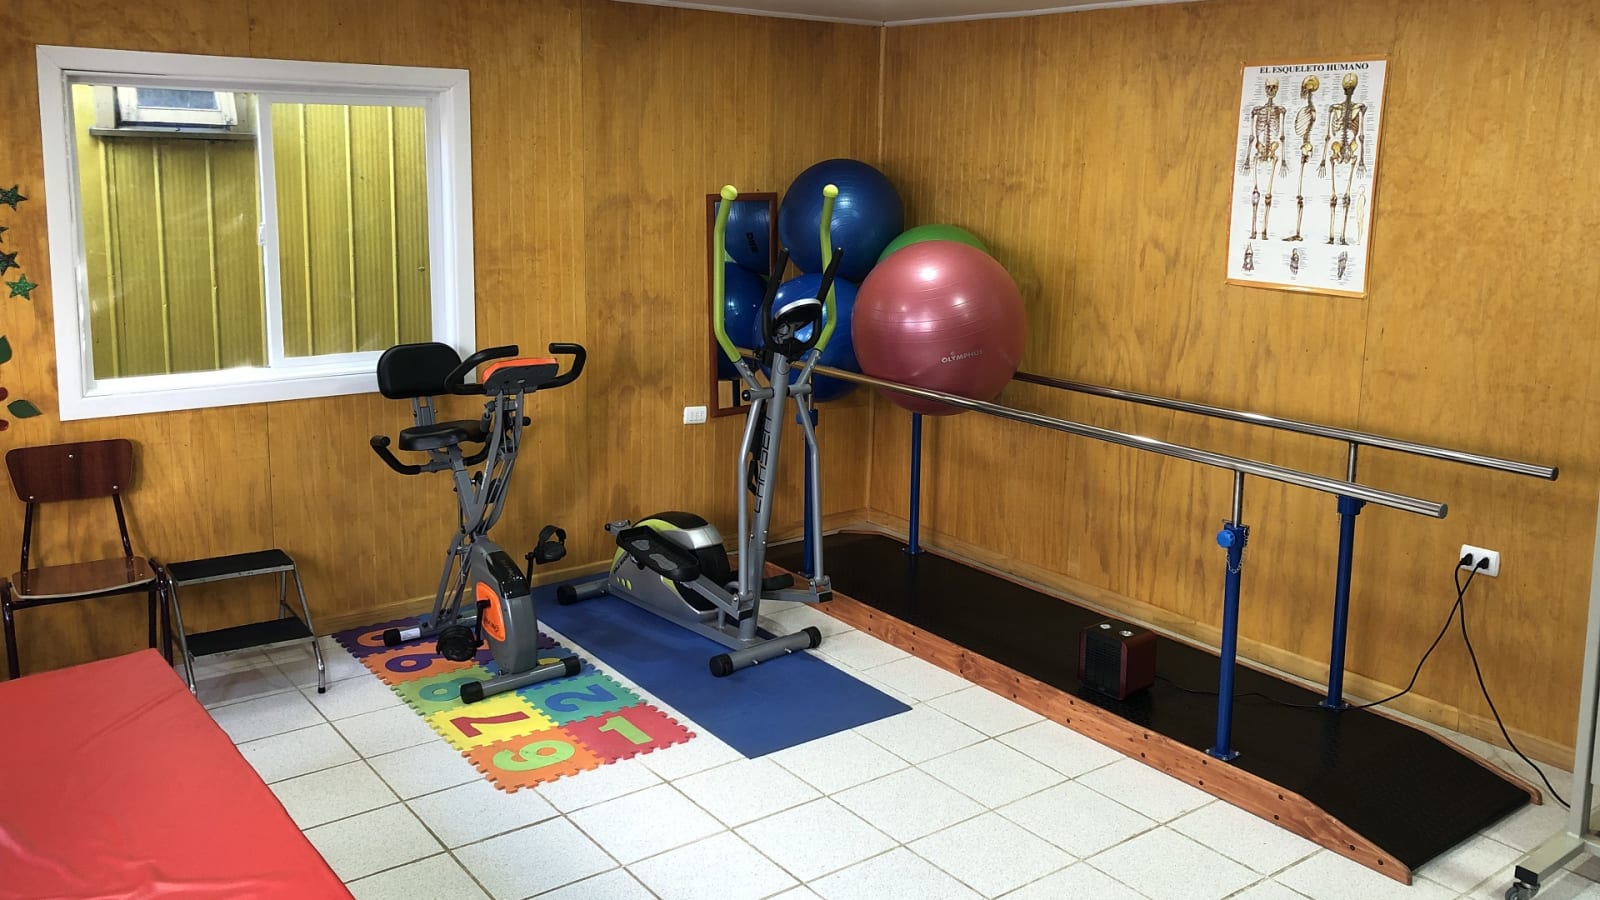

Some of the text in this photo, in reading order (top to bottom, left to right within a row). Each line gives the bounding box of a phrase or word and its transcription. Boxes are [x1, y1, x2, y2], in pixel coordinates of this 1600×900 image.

[1272, 64, 1325, 74] ESQUELETO
[1326, 62, 1369, 72] HUMANO
[544, 683, 618, 712] 2
[450, 711, 531, 738] 7
[598, 715, 654, 745] 1
